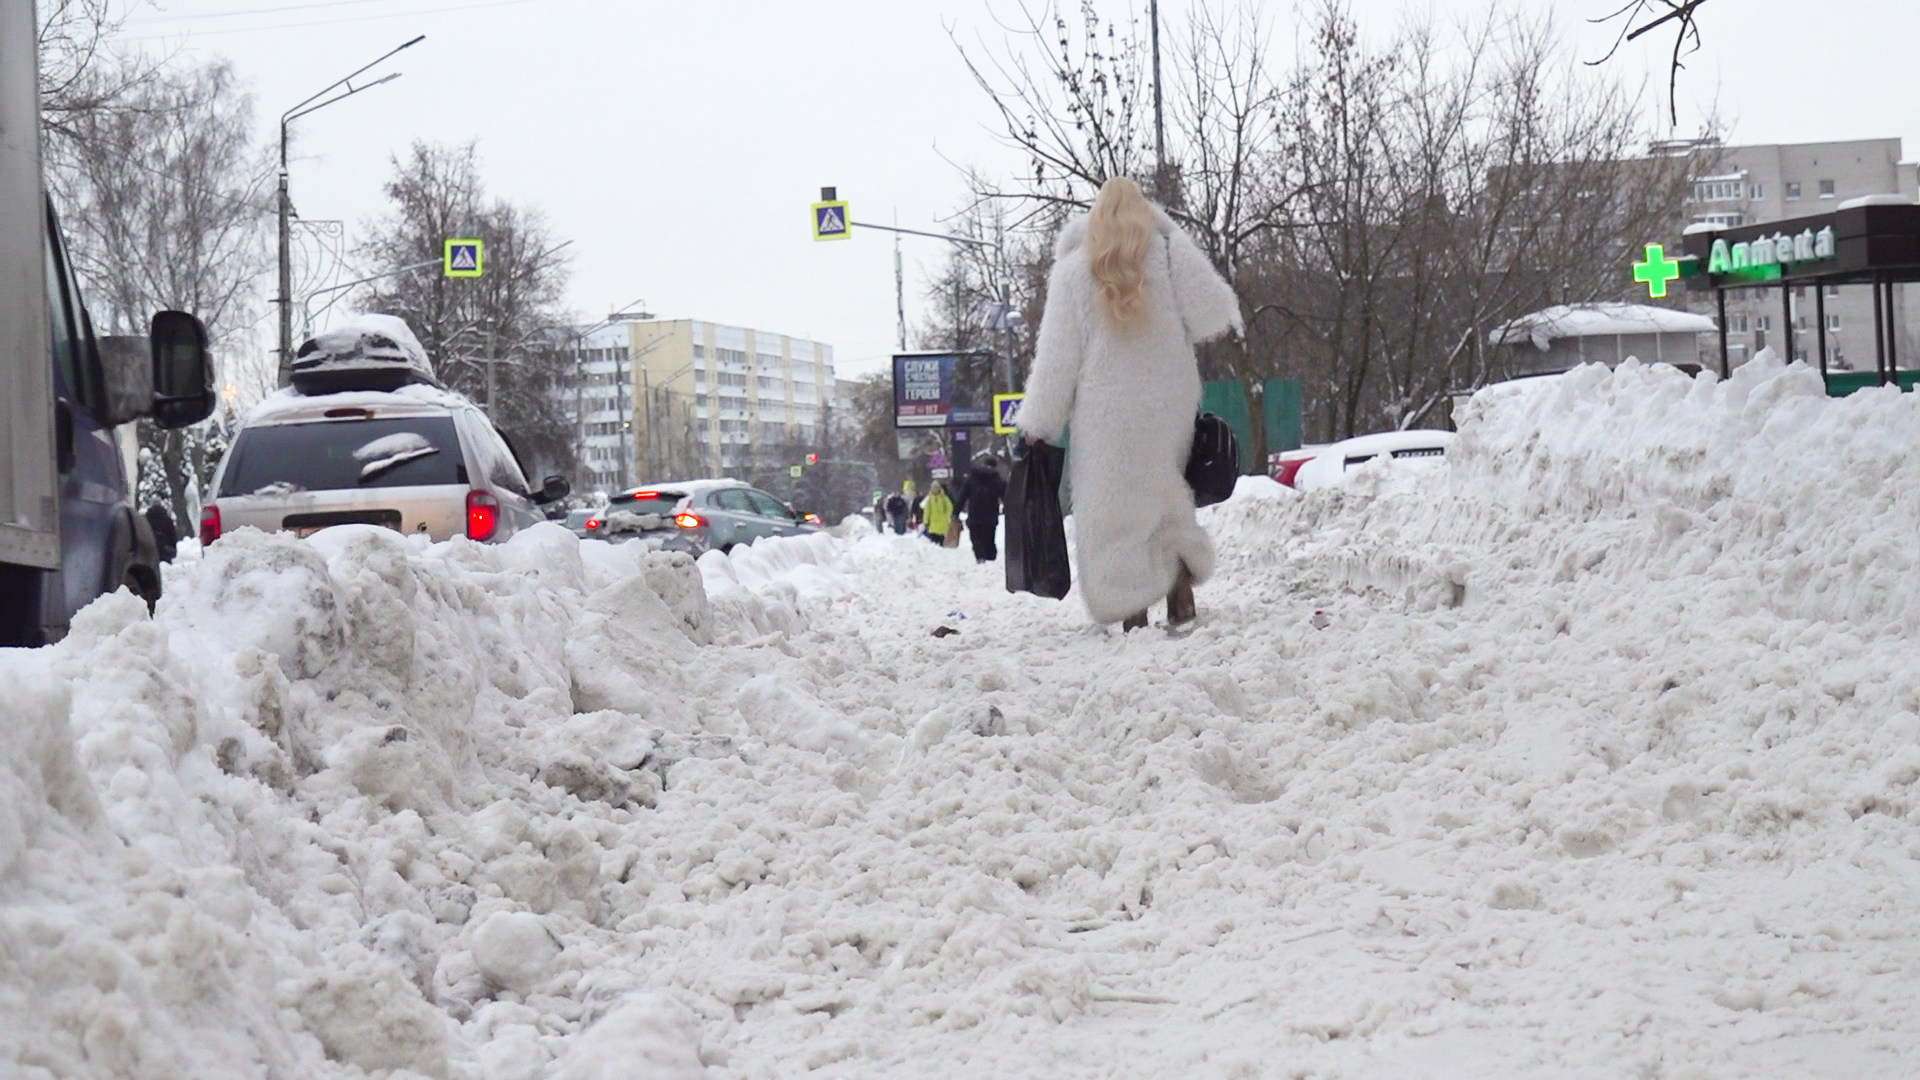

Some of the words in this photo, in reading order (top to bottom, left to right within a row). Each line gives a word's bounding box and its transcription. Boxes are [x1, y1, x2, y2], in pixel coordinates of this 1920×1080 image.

[1707, 229, 1835, 273] Аптека
[904, 360, 939, 373] СЛУЖИ
[905, 389, 940, 400] ГЕРОЕМ
